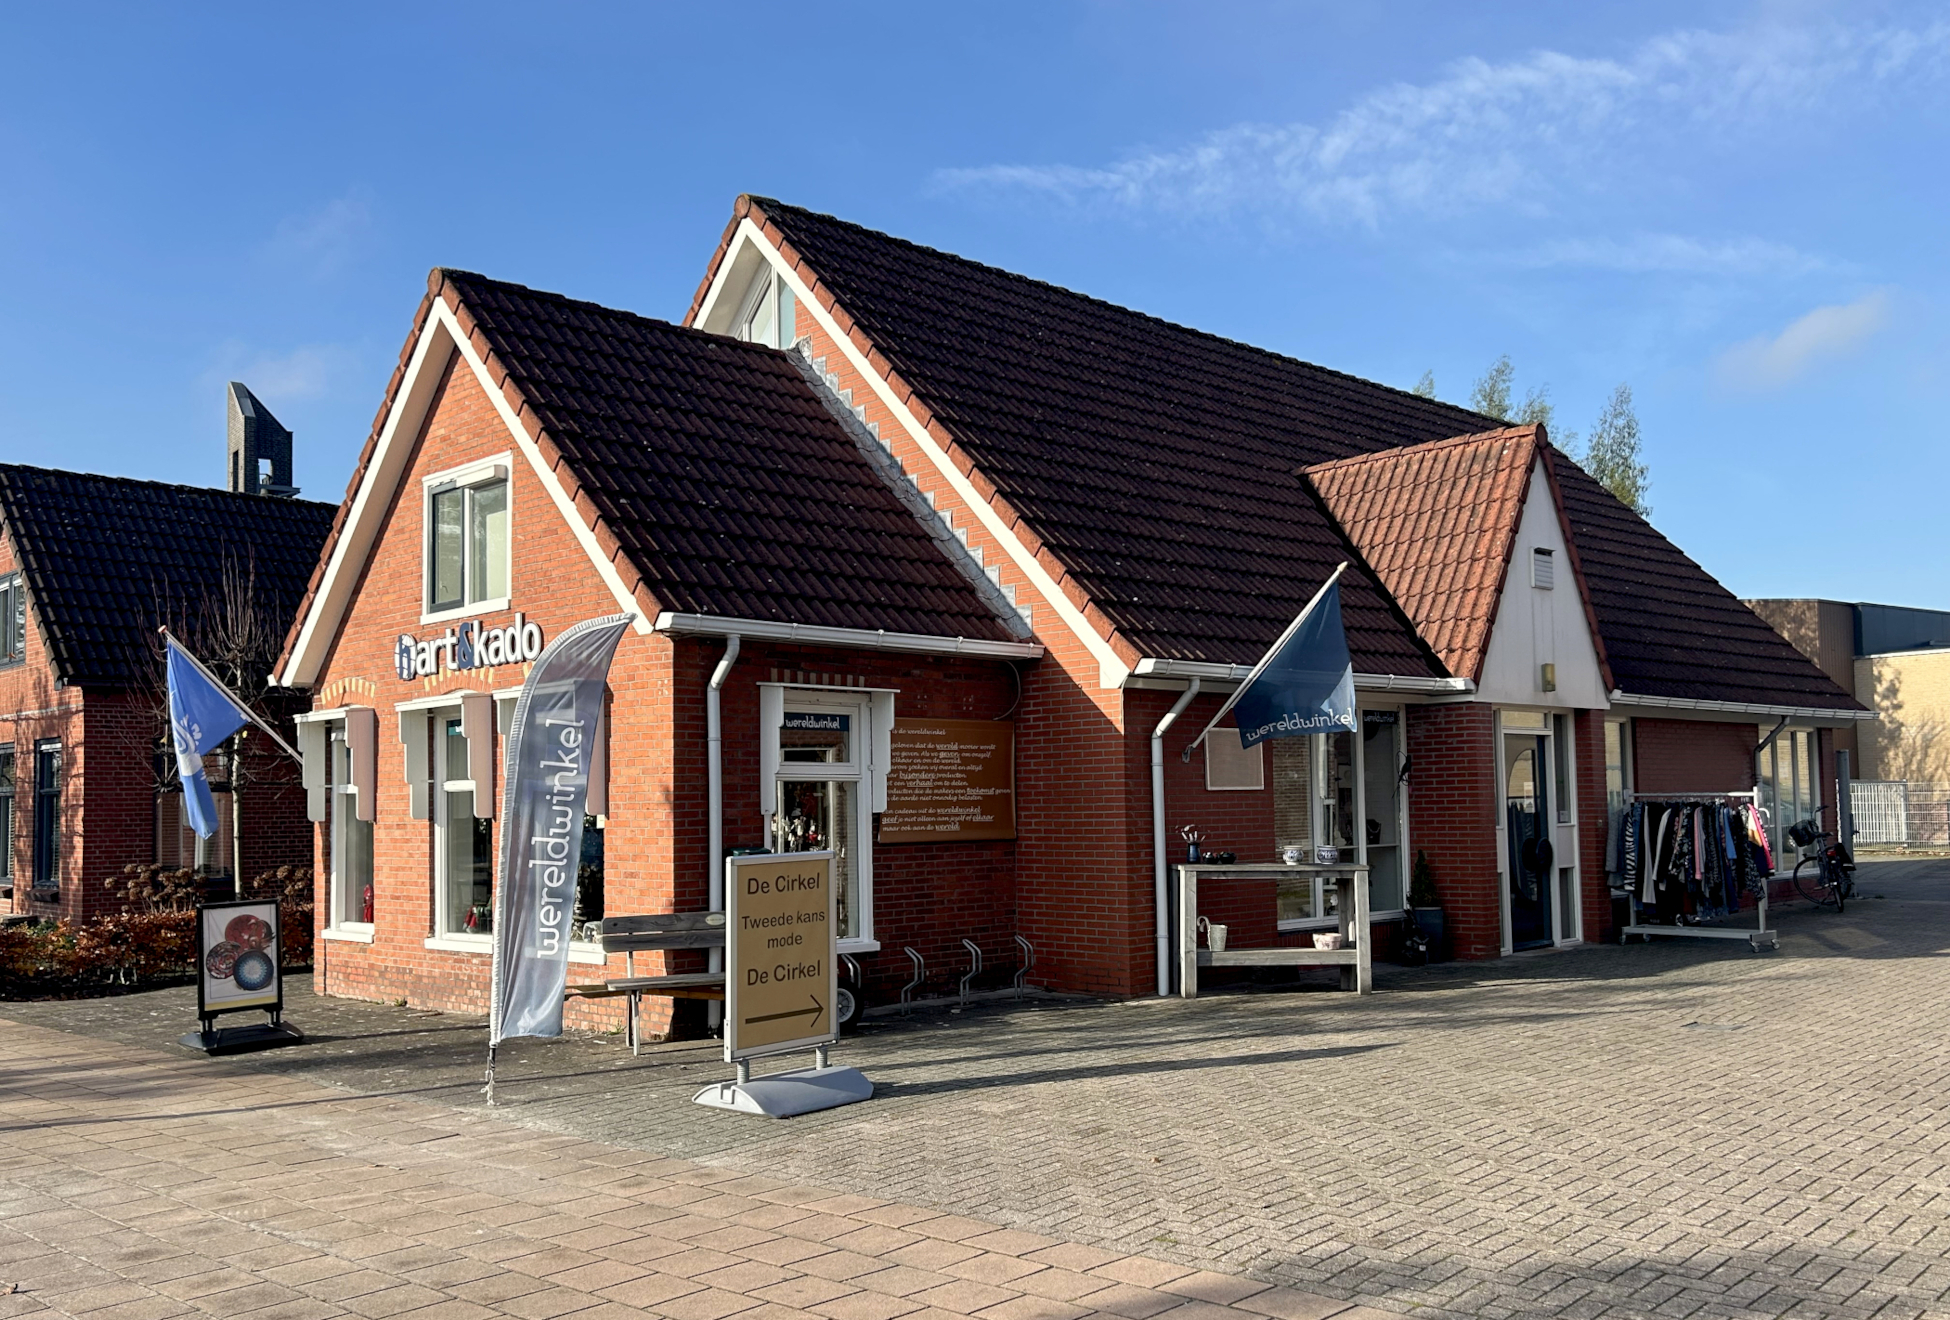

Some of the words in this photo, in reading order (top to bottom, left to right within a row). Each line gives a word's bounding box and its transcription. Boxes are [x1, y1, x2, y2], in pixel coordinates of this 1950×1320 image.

[785, 715, 840, 729] wereldwinkel
[1246, 708, 1354, 741] wereldwinkel
[528, 718, 585, 958] wereldwinkel
[747, 878, 770, 895] De
[775, 872, 820, 893] Cirkel
[742, 912, 793, 930] Tweede
[796, 910, 825, 924] kans
[767, 932, 803, 949] mode
[747, 968, 769, 986] De
[774, 960, 821, 982] Cirkel
